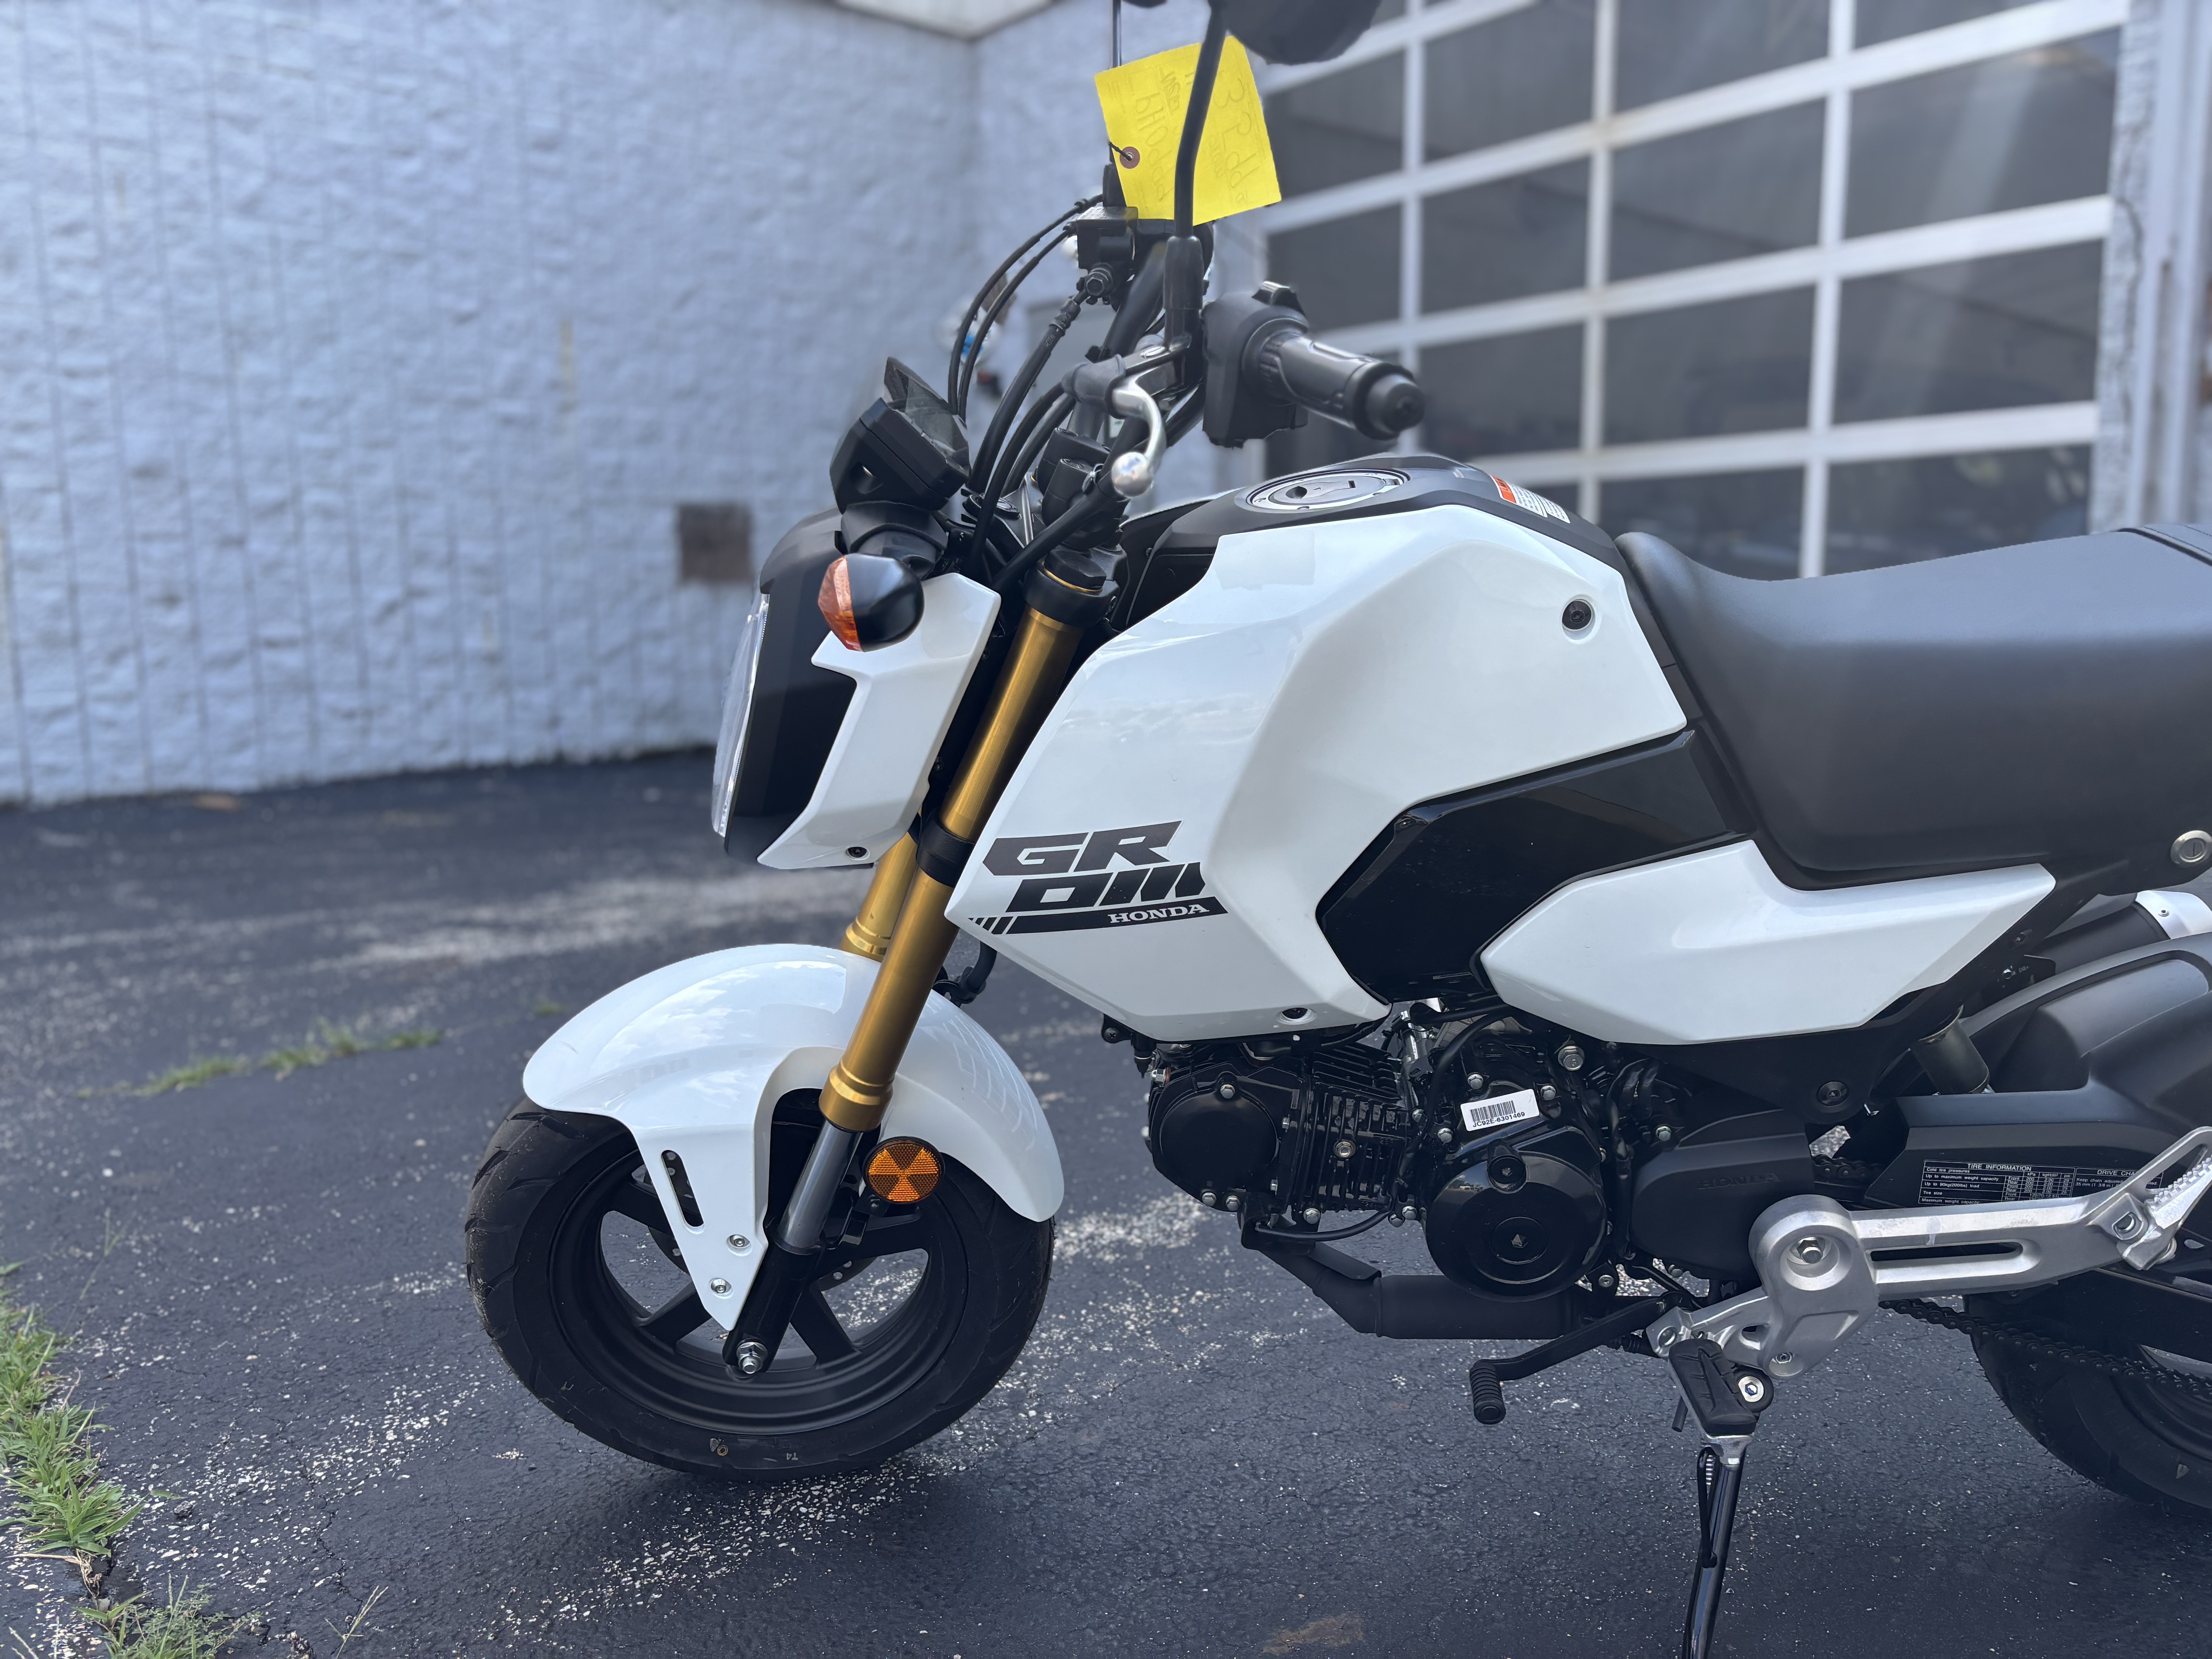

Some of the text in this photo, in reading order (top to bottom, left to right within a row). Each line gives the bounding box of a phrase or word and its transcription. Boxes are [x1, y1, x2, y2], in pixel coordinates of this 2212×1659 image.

[1108, 903, 1210, 923] HONDA
[1473, 1111, 1525, 1127] JC92E-6301469
[1698, 1173, 1783, 1190] HONDA
